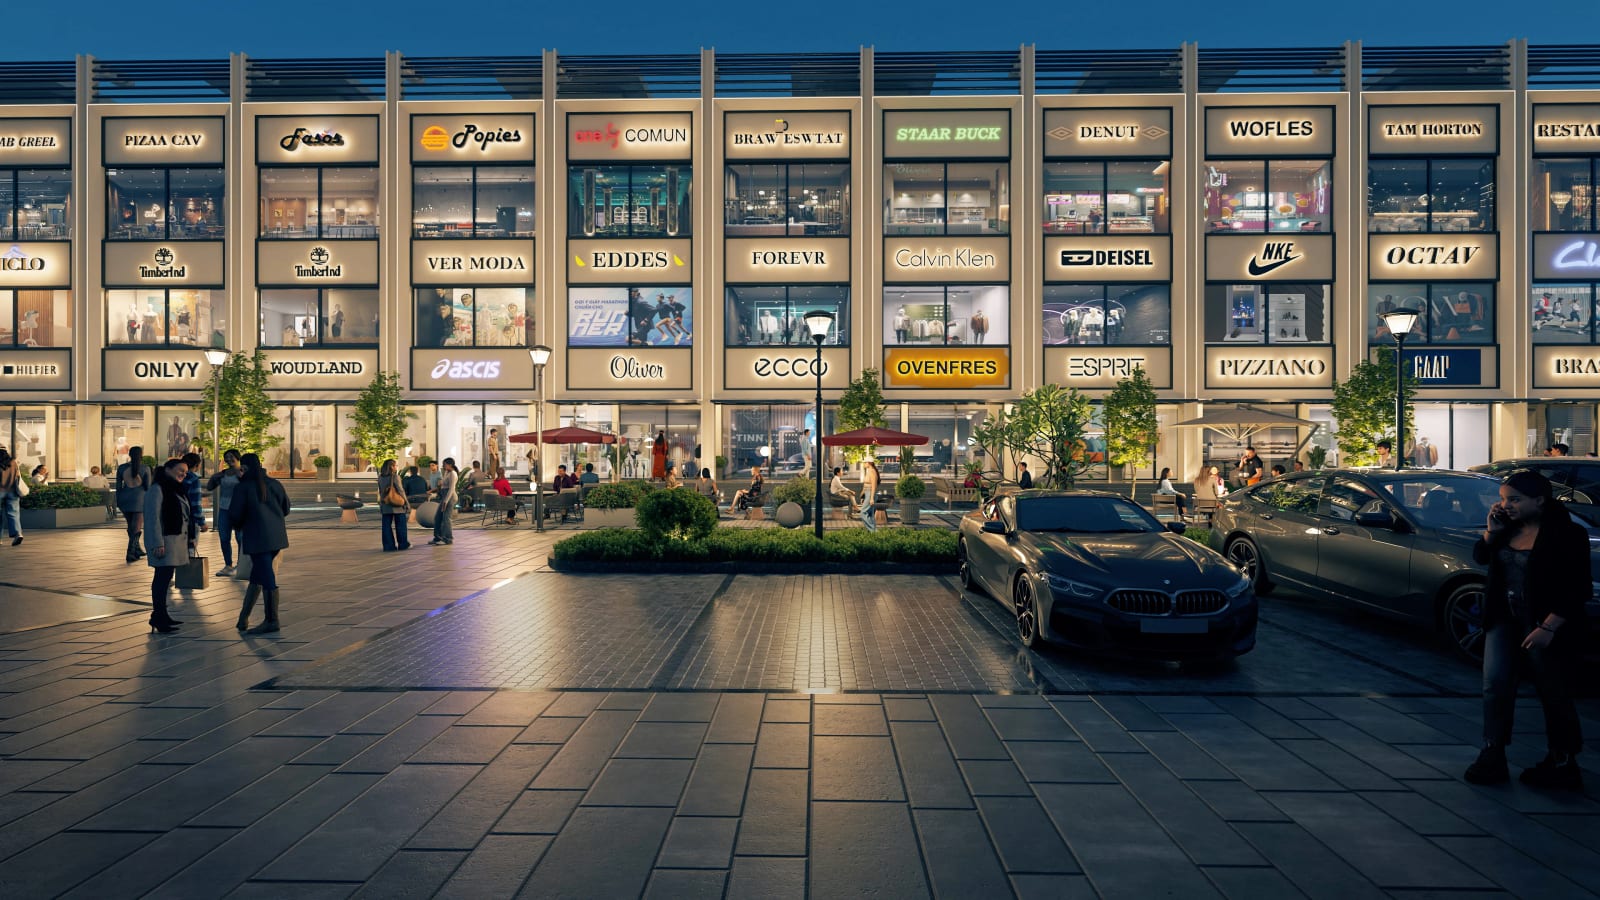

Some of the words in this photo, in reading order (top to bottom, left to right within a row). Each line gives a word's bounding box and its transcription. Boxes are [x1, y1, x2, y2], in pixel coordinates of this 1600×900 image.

[452, 124, 522, 150] Popies
[625, 128, 687, 142] COMUN
[896, 128, 952, 141] STAAR
[954, 127, 1001, 141] BUCK
[1080, 125, 1139, 138] DENUT
[1230, 121, 1313, 137] WOFLES
[1385, 124, 1417, 135] TAM
[1422, 123, 1482, 135] HORTON
[1537, 124, 1600, 136] RESTA
[18, 136, 56, 147] GREEL
[125, 134, 168, 146] PIZAA
[171, 134, 202, 146] CAV
[280, 128, 344, 151] Fasos
[734, 133, 778, 145] BRAW
[783, 132, 843, 145] ESWTAT
[751, 251, 826, 265] FOREVR
[895, 249, 951, 267] Calvin
[955, 249, 995, 267] Klen
[1095, 250, 1154, 266] DEISEL
[1262, 242, 1294, 260] NKE
[1387, 246, 1480, 265] OCTAV
[1553, 241, 1600, 268] Cl
[427, 257, 462, 270] VER
[469, 257, 526, 270] MODA
[591, 251, 668, 268] EDDES
[16, 365, 57, 375] HILFIER
[134, 362, 199, 378] ONLYY
[271, 361, 363, 374] WOUDLAND
[448, 360, 501, 379] ascis
[610, 355, 664, 379] Oliver
[754, 358, 828, 377] ecco
[897, 360, 997, 375] OVENFRES
[1070, 357, 1145, 376] ESPRIT
[1220, 359, 1326, 376] PIZZIANO
[1556, 359, 1600, 374] BRA
